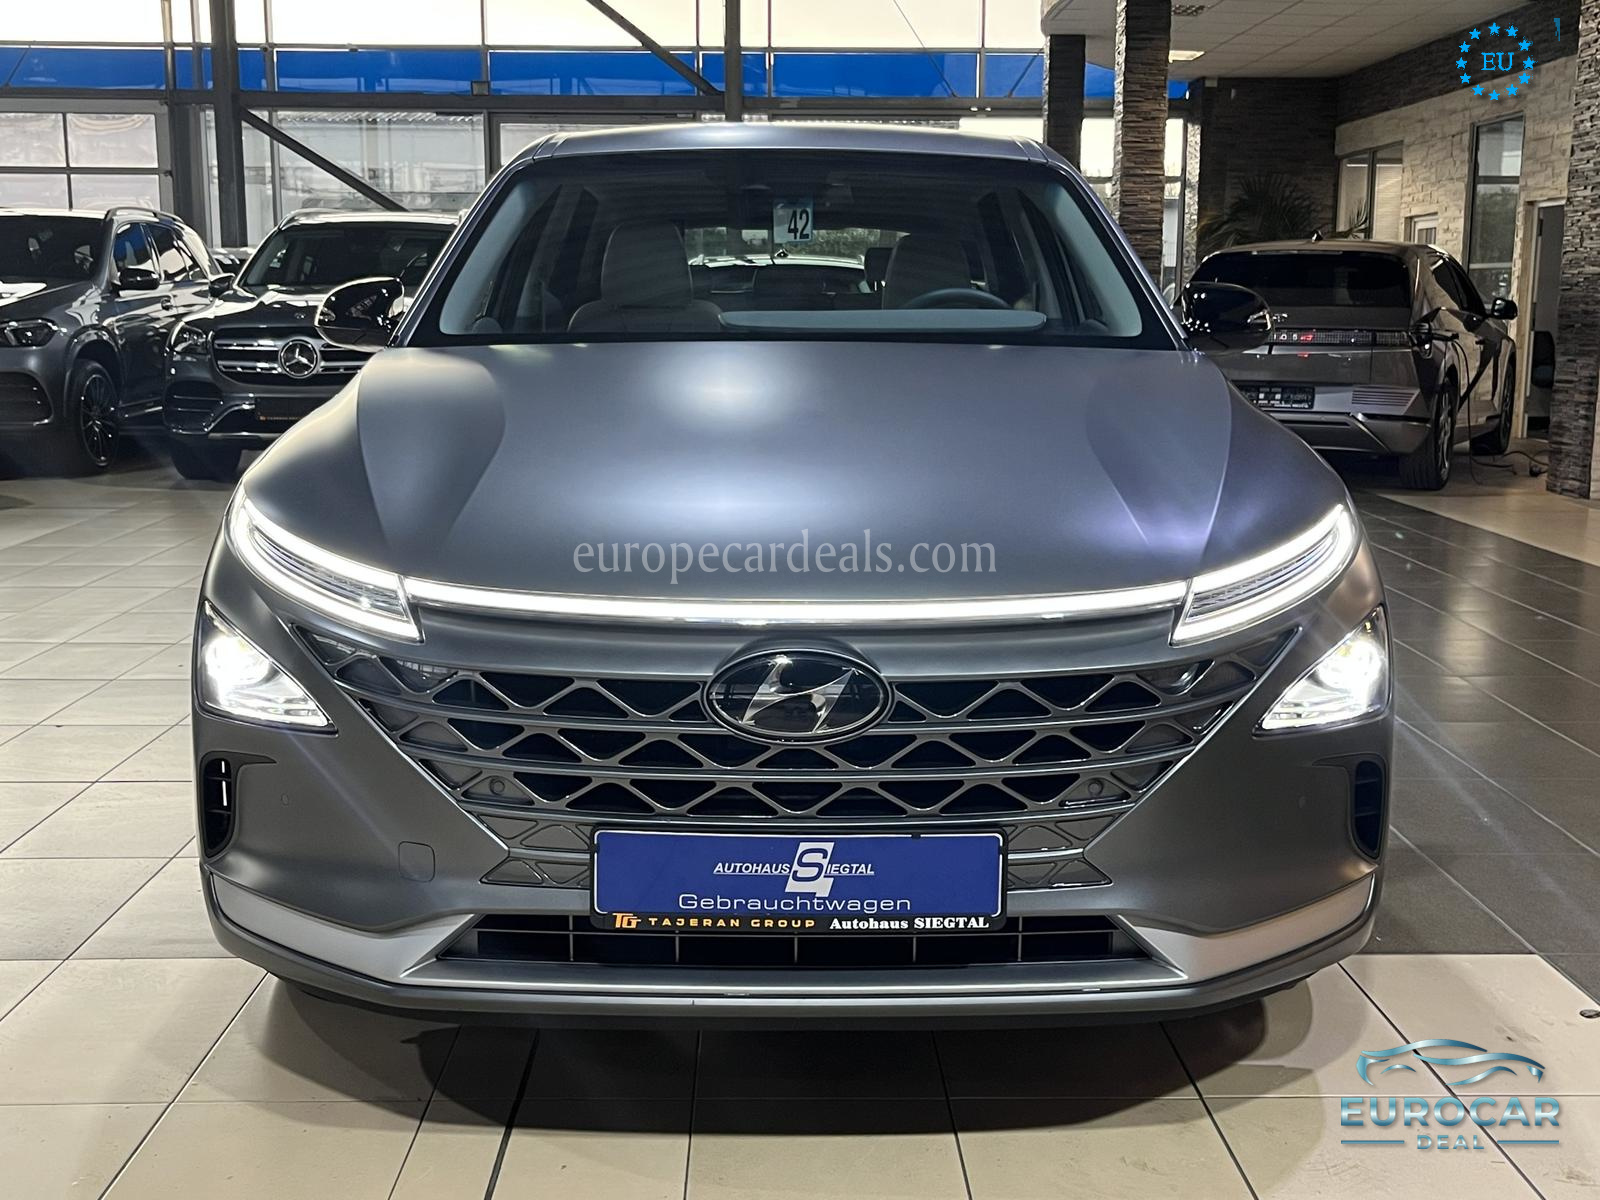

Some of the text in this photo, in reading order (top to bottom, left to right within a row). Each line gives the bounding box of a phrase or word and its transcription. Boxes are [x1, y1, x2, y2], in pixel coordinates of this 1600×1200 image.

[788, 208, 810, 240] 42
[713, 862, 791, 875] AUTOHAUS
[678, 894, 911, 914] Gebrauchtwagen
[648, 917, 740, 928] TAJERAN
[750, 918, 816, 929] GROUP
[829, 916, 990, 930] Autohaus SIEGTAL
